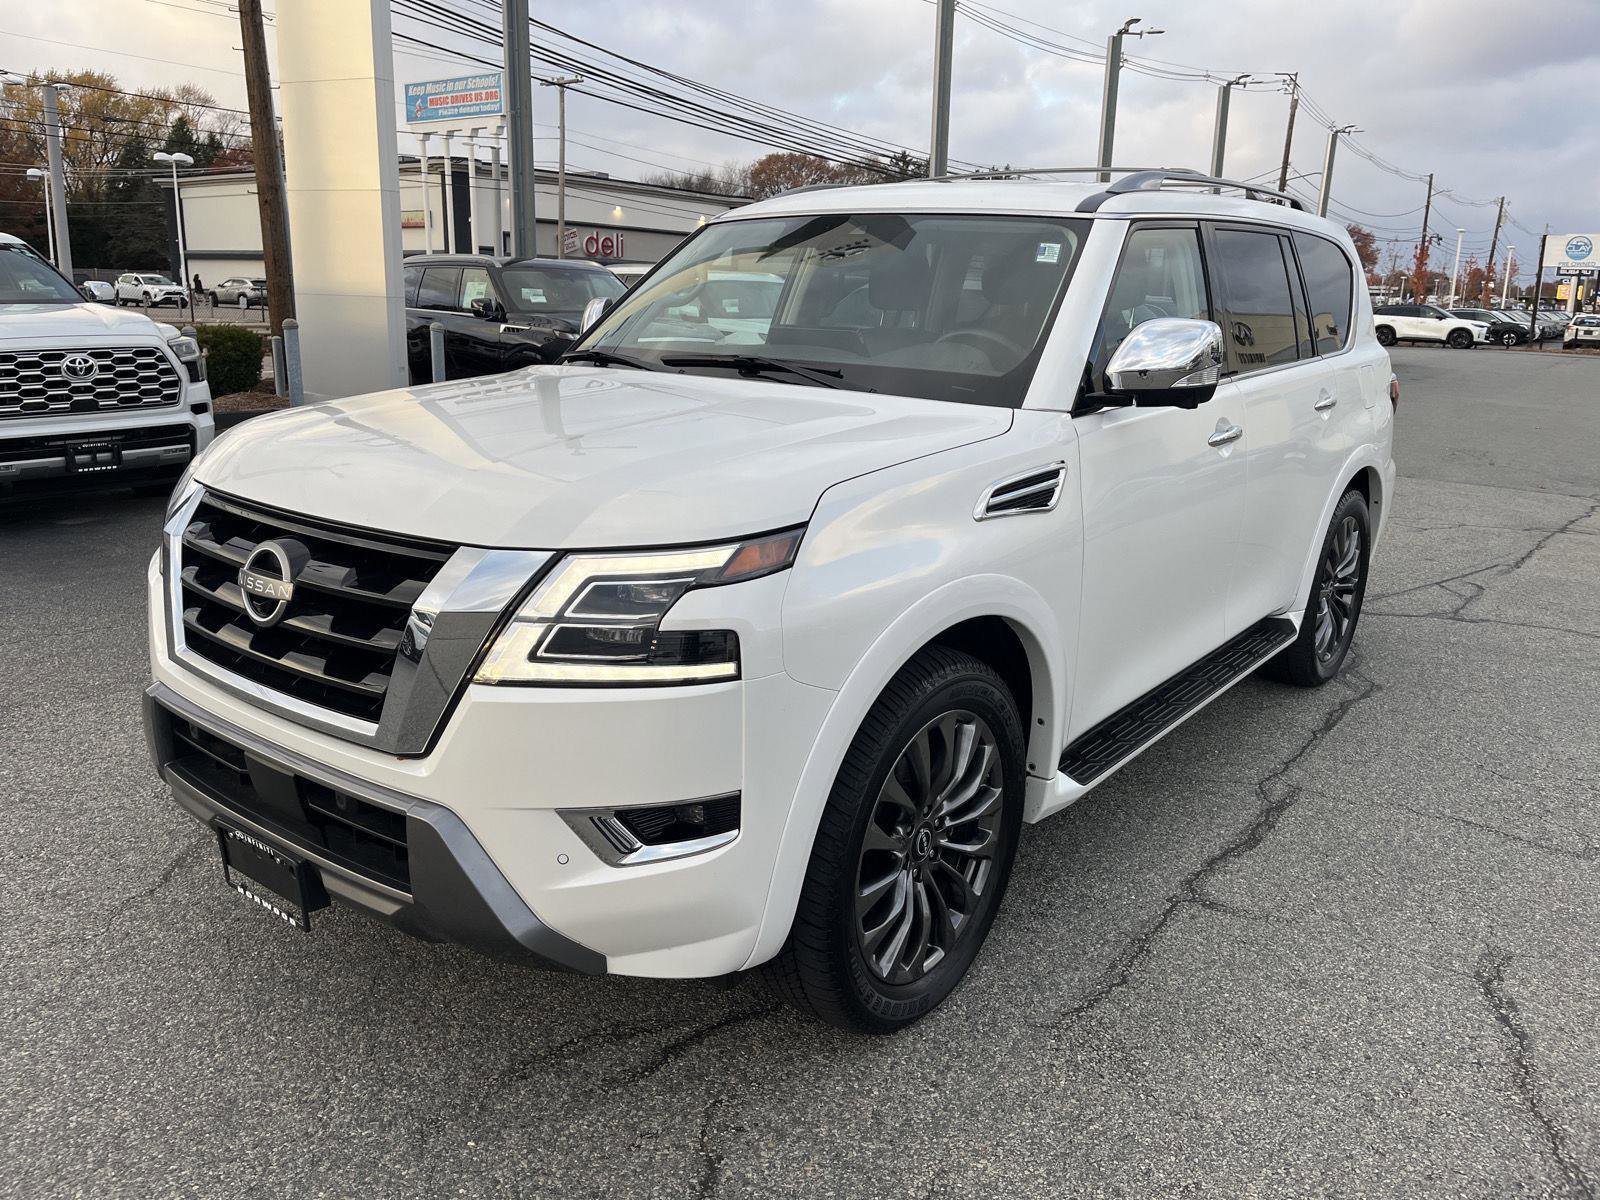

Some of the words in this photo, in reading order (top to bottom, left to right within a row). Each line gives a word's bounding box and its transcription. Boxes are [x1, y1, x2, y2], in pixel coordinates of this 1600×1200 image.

[408, 85, 425, 97] Keep
[425, 82, 447, 94] Music
[454, 80, 466, 91] our
[467, 75, 499, 89] Schools!
[428, 96, 450, 107] MUSIC
[450, 93, 474, 105] DRIVES
[582, 229, 624, 258] deli
[239, 572, 291, 598] NISSAN
